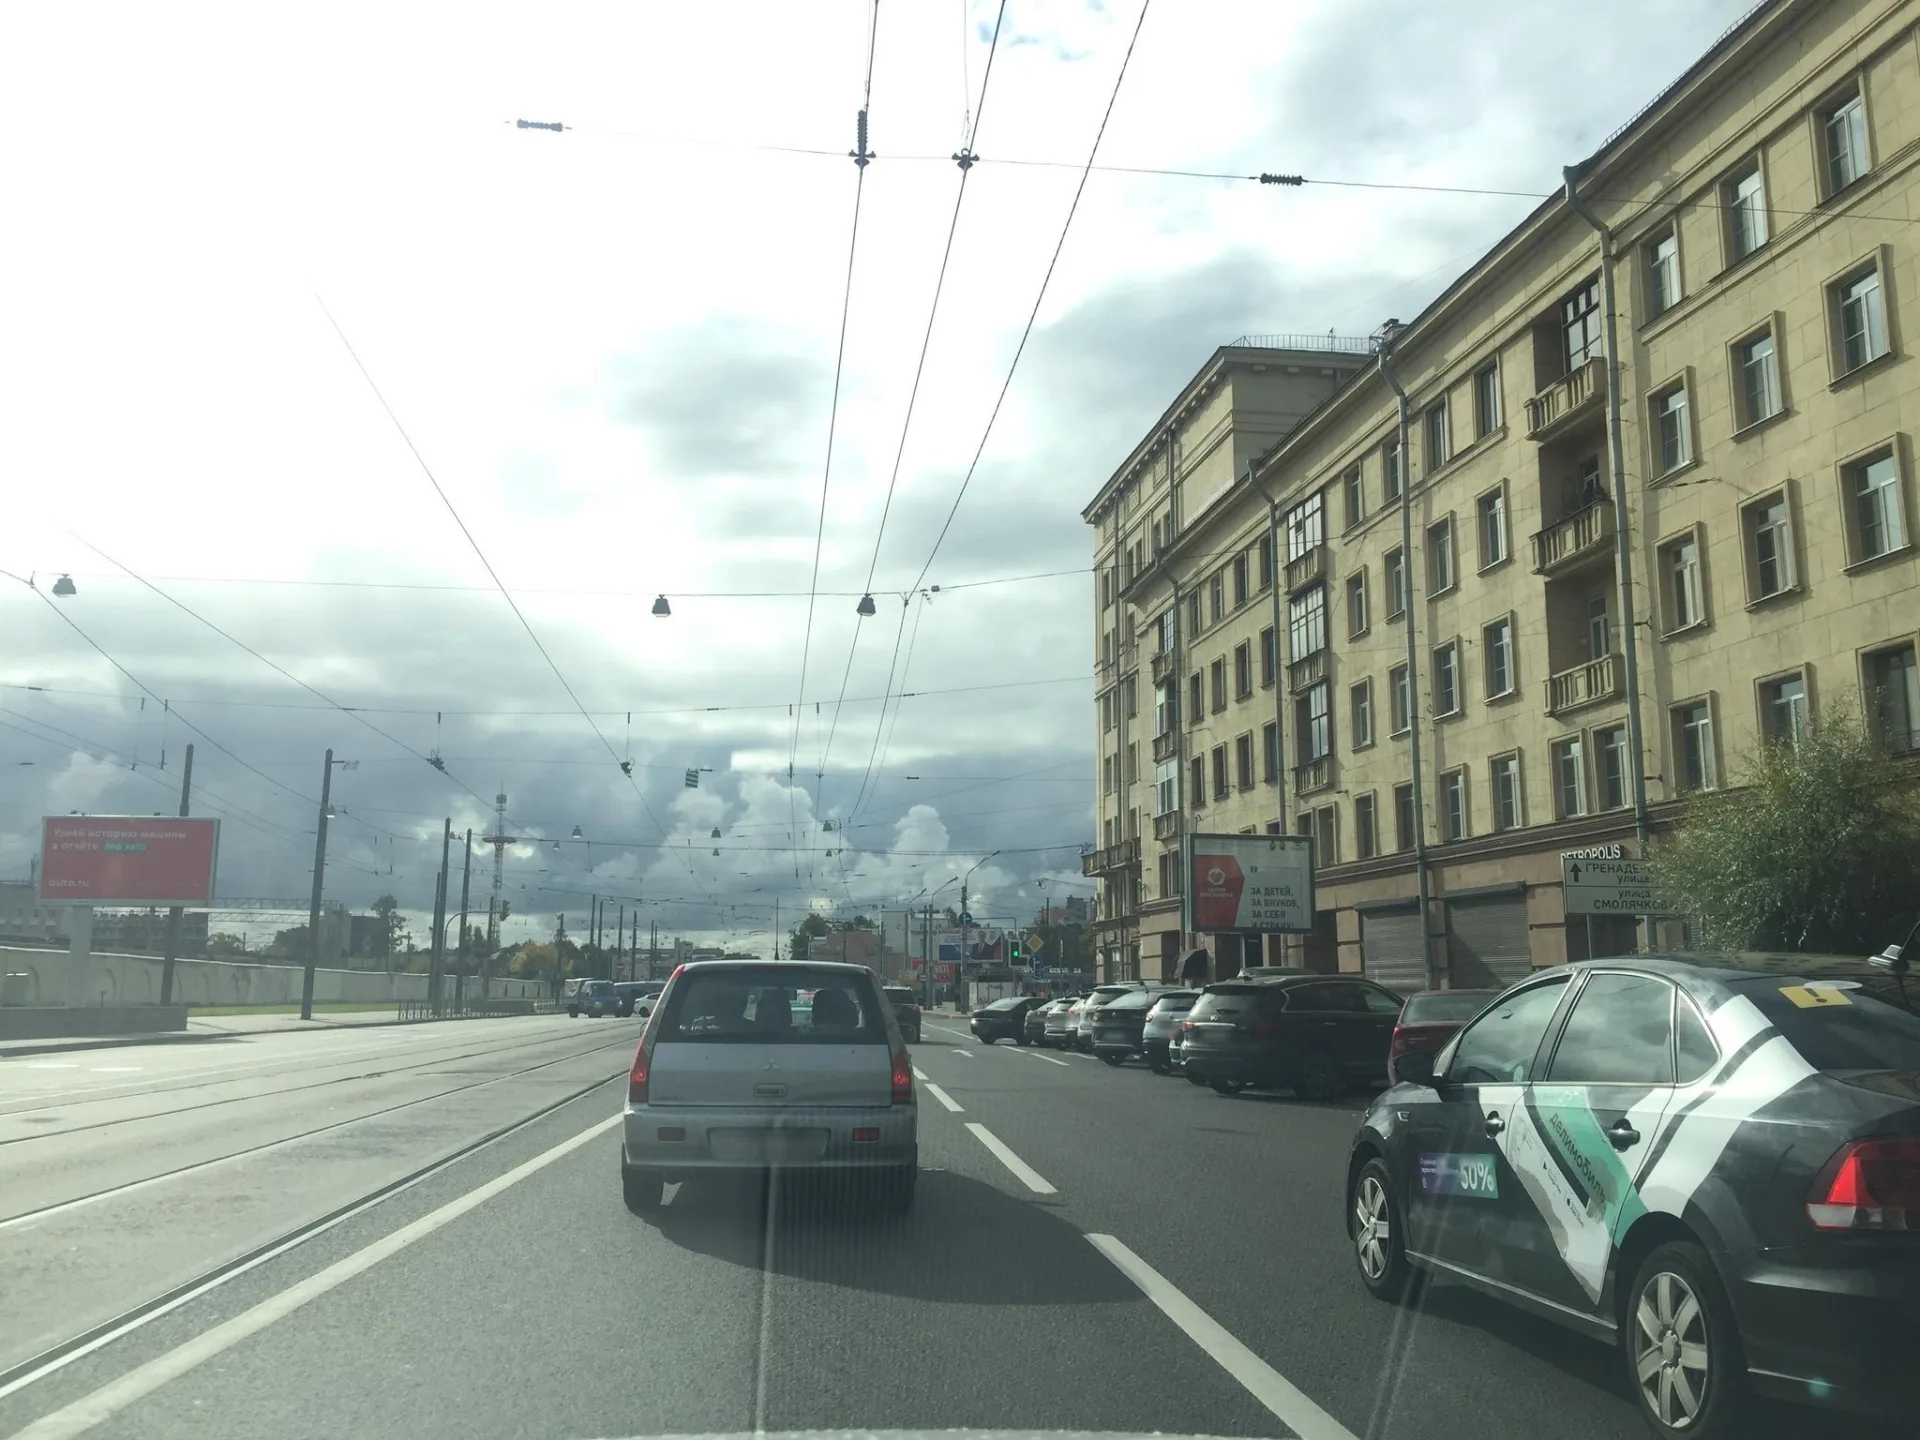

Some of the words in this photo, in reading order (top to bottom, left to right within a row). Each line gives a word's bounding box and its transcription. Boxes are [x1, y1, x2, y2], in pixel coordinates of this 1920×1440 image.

[53, 827, 85, 838] Узнай
[88, 829, 138, 841] историю
[140, 831, 187, 840] машины
[48, 878, 90, 888] auto.ru
[1617, 875, 1650, 885] улица
[1250, 887, 1261, 896] ЗА
[1263, 886, 1294, 897] ДЕТЕЙ,
[1618, 890, 1651, 900] улица
[1250, 899, 1262, 908] ЗА
[1263, 899, 1300, 909] ВНУКОВ,
[1251, 910, 1262, 919] ЗА
[1264, 910, 1286, 919] СЕБЯ
